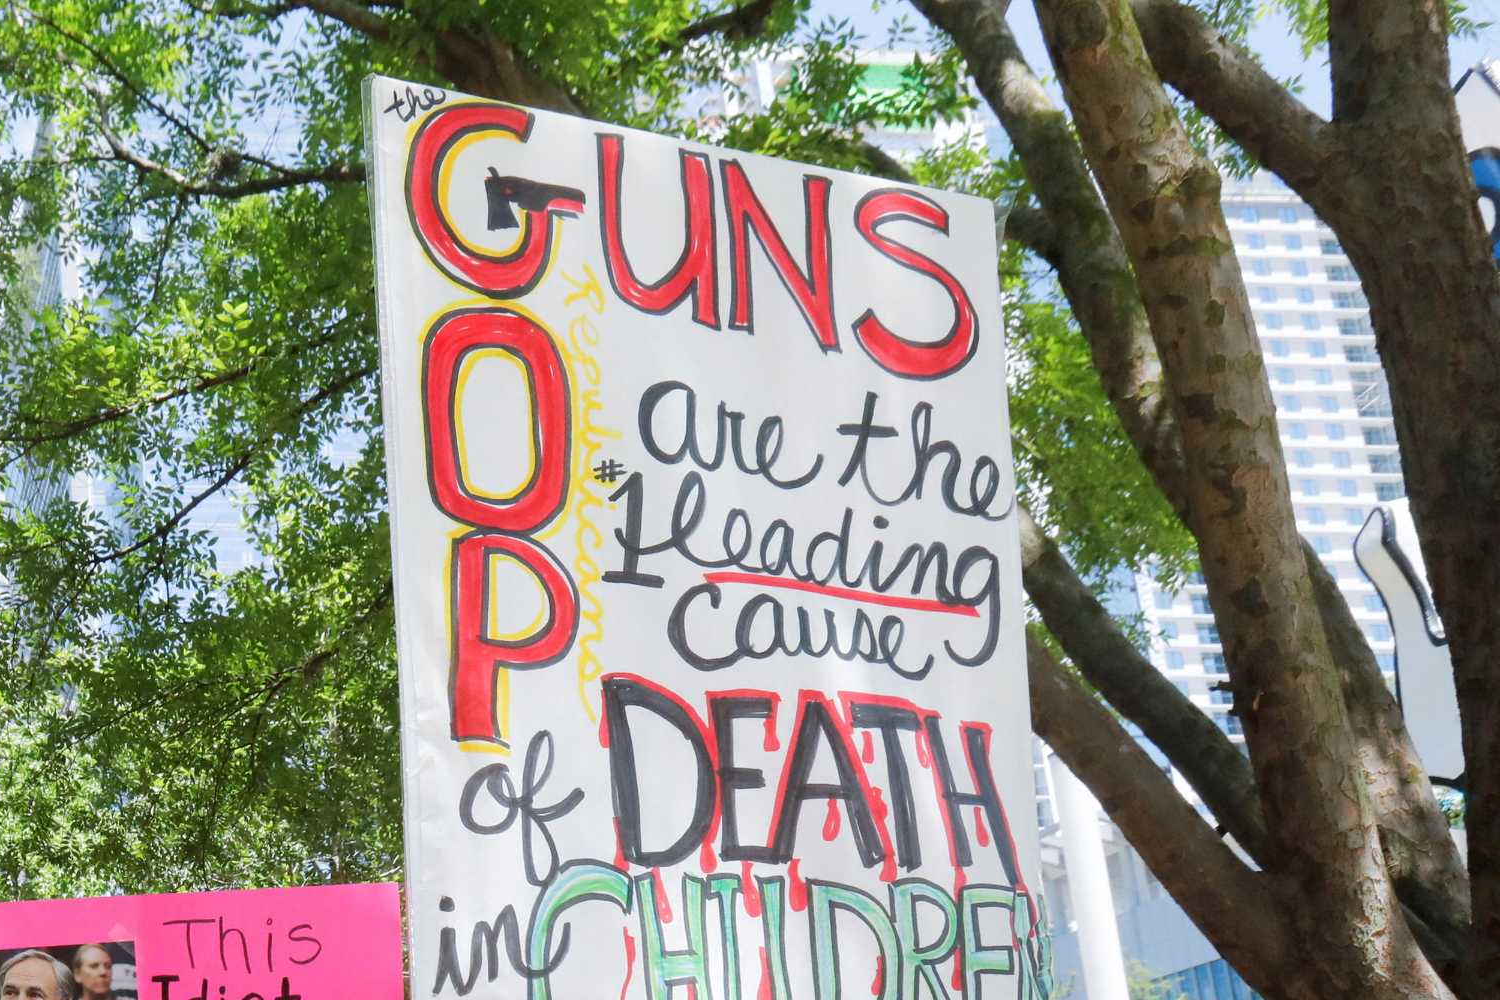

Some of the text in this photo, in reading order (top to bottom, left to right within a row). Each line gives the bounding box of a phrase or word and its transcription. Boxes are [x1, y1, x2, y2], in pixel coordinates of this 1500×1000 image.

[384, 86, 446, 122] the
[405, 102, 979, 381] GUNS
[639, 380, 1015, 521] are the
[615, 470, 1001, 664] leading
[667, 583, 934, 681] cause
[460, 674, 1022, 886] of DEATH
[163, 917, 322, 974] This
[433, 896, 571, 997] in
